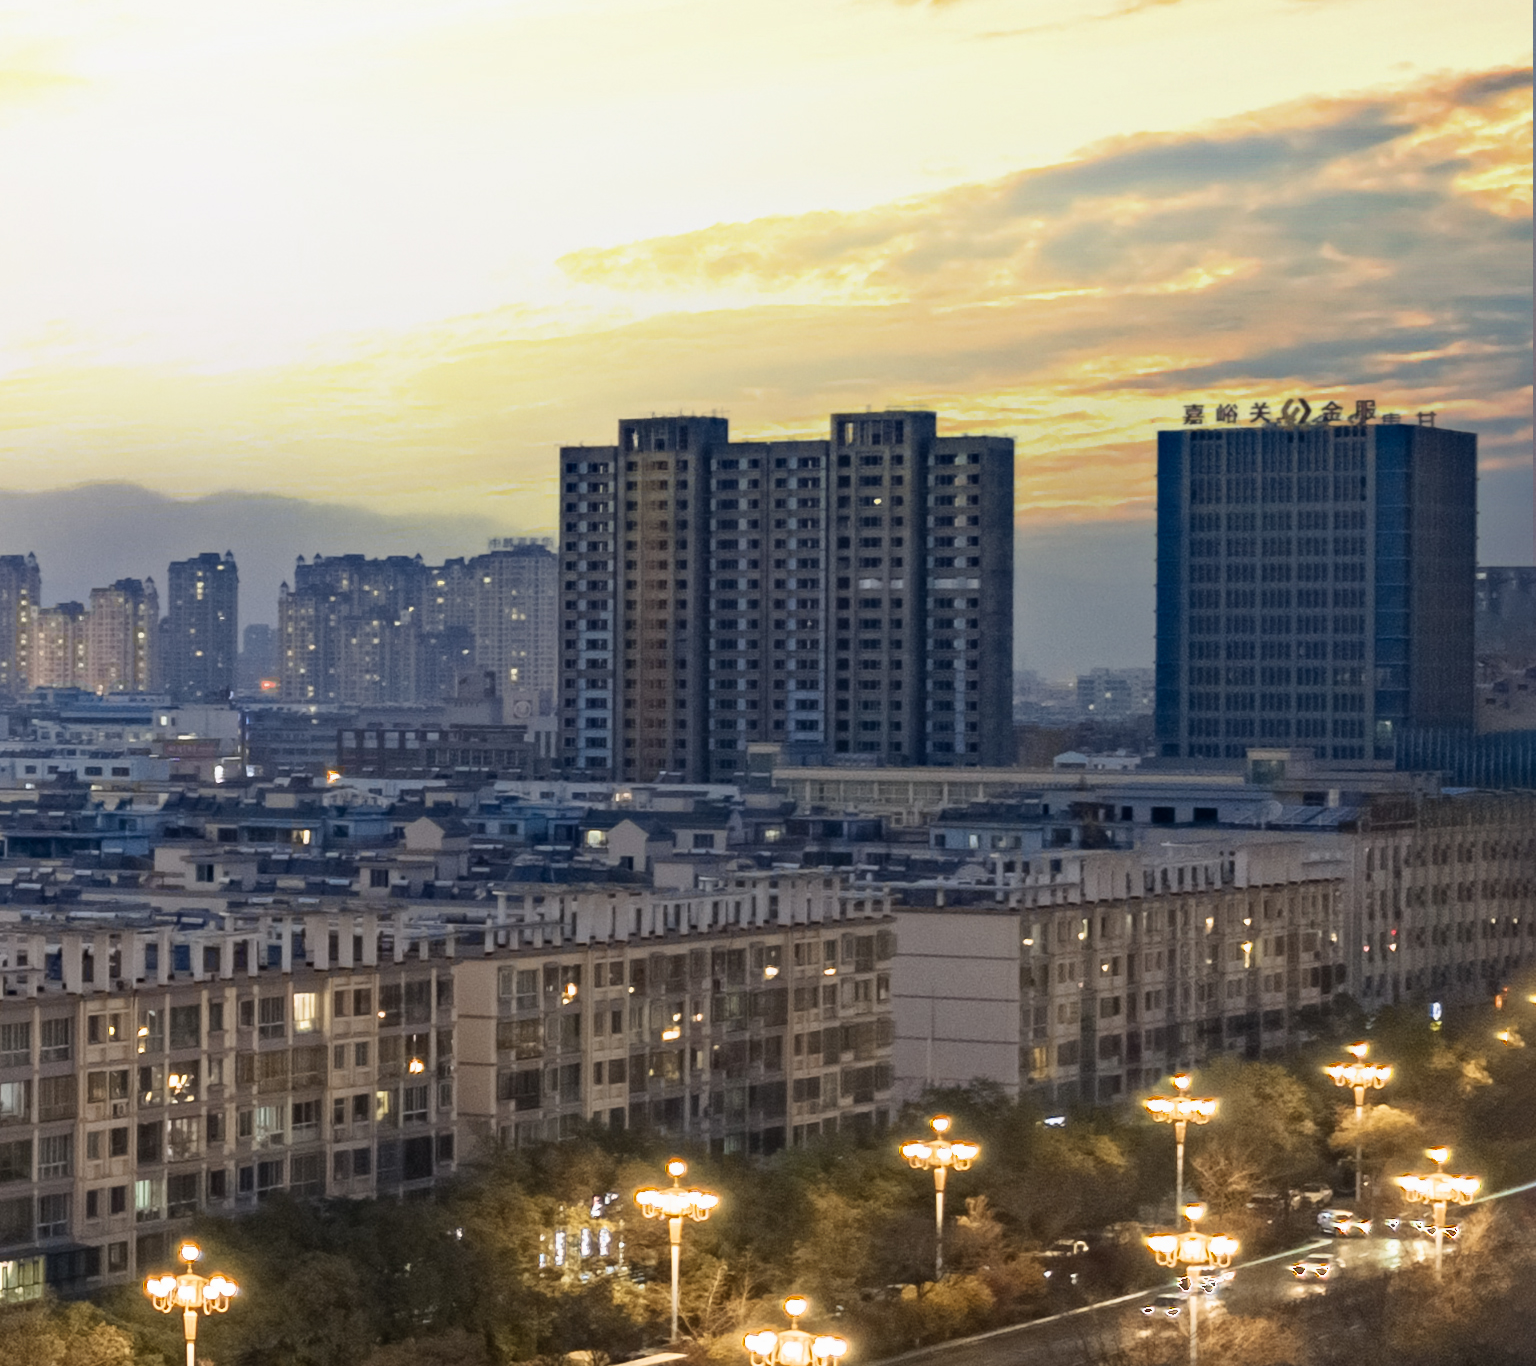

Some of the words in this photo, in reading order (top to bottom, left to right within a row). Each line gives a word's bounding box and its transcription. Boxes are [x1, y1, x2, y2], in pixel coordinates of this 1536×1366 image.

[1182, 402, 1272, 426] 嘉峪关
[1321, 399, 1377, 422] 金服
